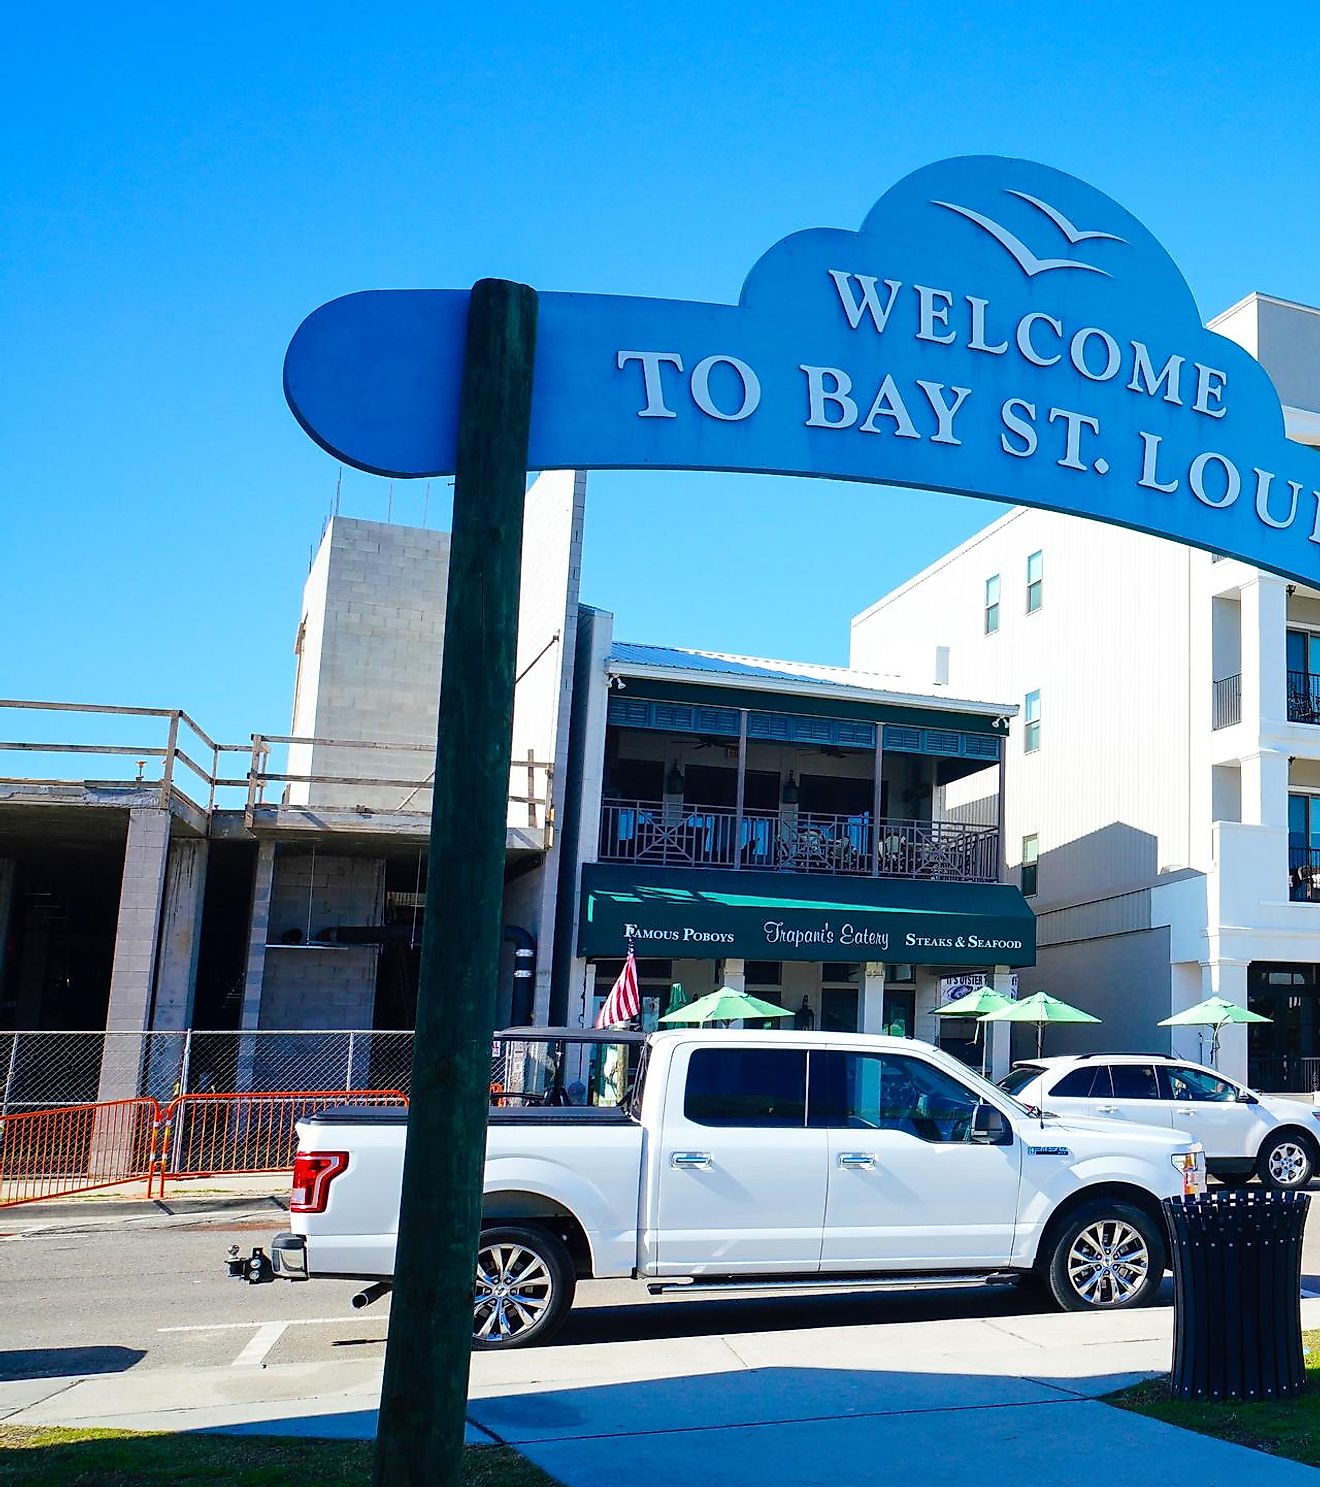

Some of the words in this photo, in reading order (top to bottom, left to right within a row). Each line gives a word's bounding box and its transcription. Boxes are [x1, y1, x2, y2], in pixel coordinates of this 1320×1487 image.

[828, 268, 1229, 420] WELCOME
[616, 350, 762, 423] TO
[799, 362, 973, 446] BAY
[1000, 397, 1111, 475] ST.
[623, 923, 680, 941] FAMOUS
[682, 926, 735, 943] POBOYS
[763, 921, 834, 948] Trapani's
[839, 923, 889, 951] Eatery
[905, 932, 953, 948] STEAKS
[954, 936, 966, 948] &
[967, 935, 1022, 949] SEAFOOD
